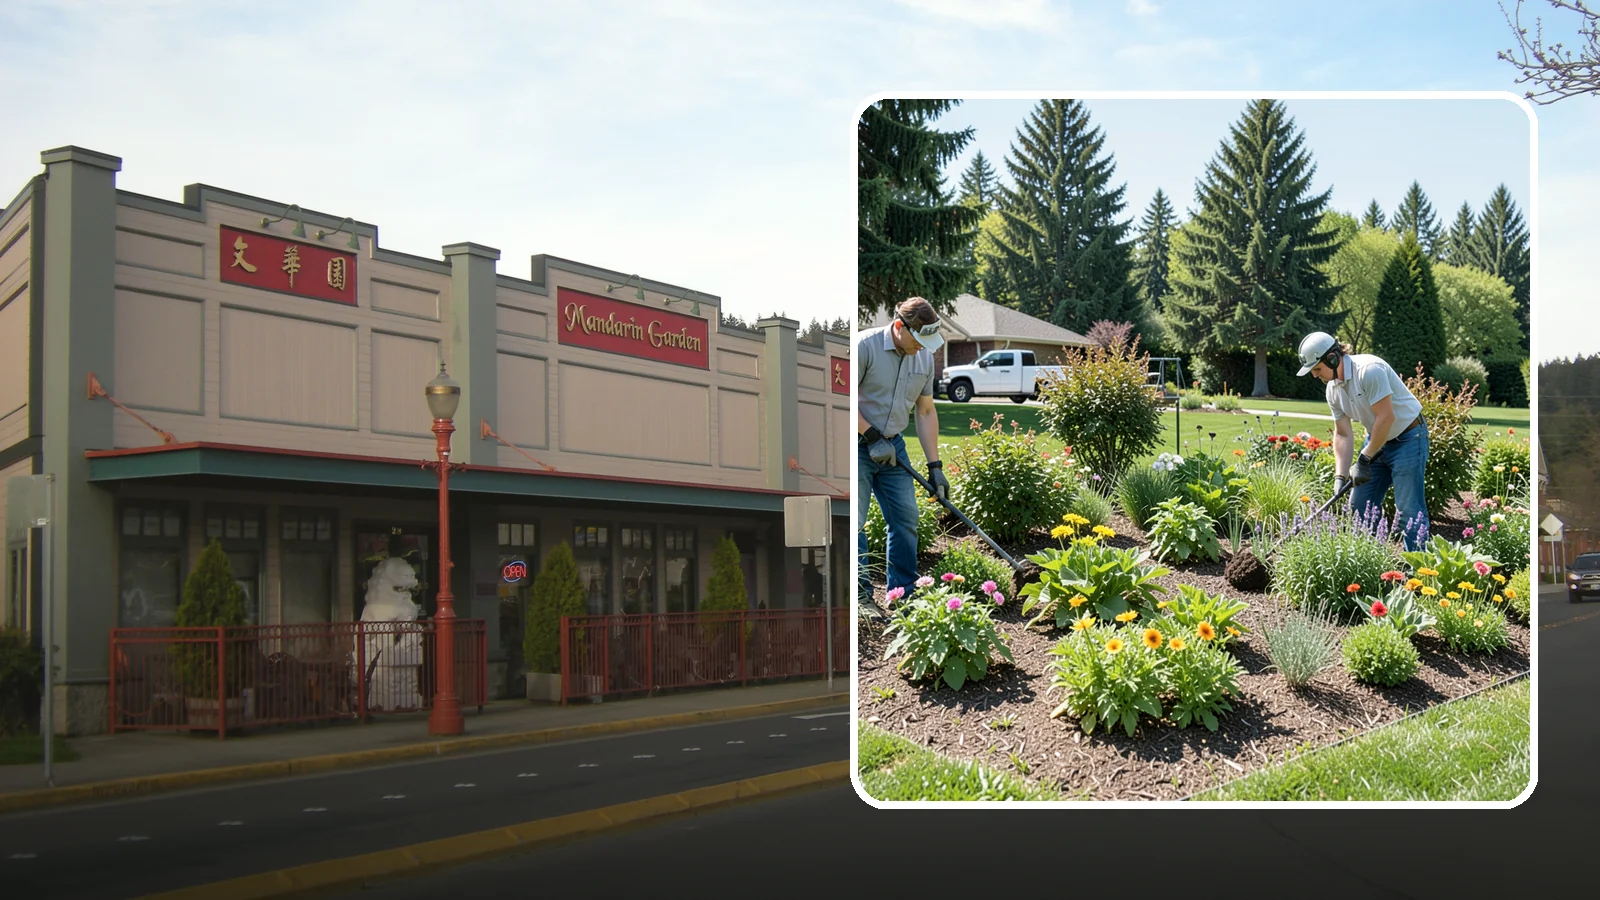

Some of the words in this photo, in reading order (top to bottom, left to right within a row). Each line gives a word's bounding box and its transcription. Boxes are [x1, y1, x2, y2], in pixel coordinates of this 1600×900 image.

[230, 235, 346, 291] 文華園
[564, 302, 644, 341] Mandarin
[648, 320, 701, 352] Garden
[503, 565, 527, 578] OPEN
